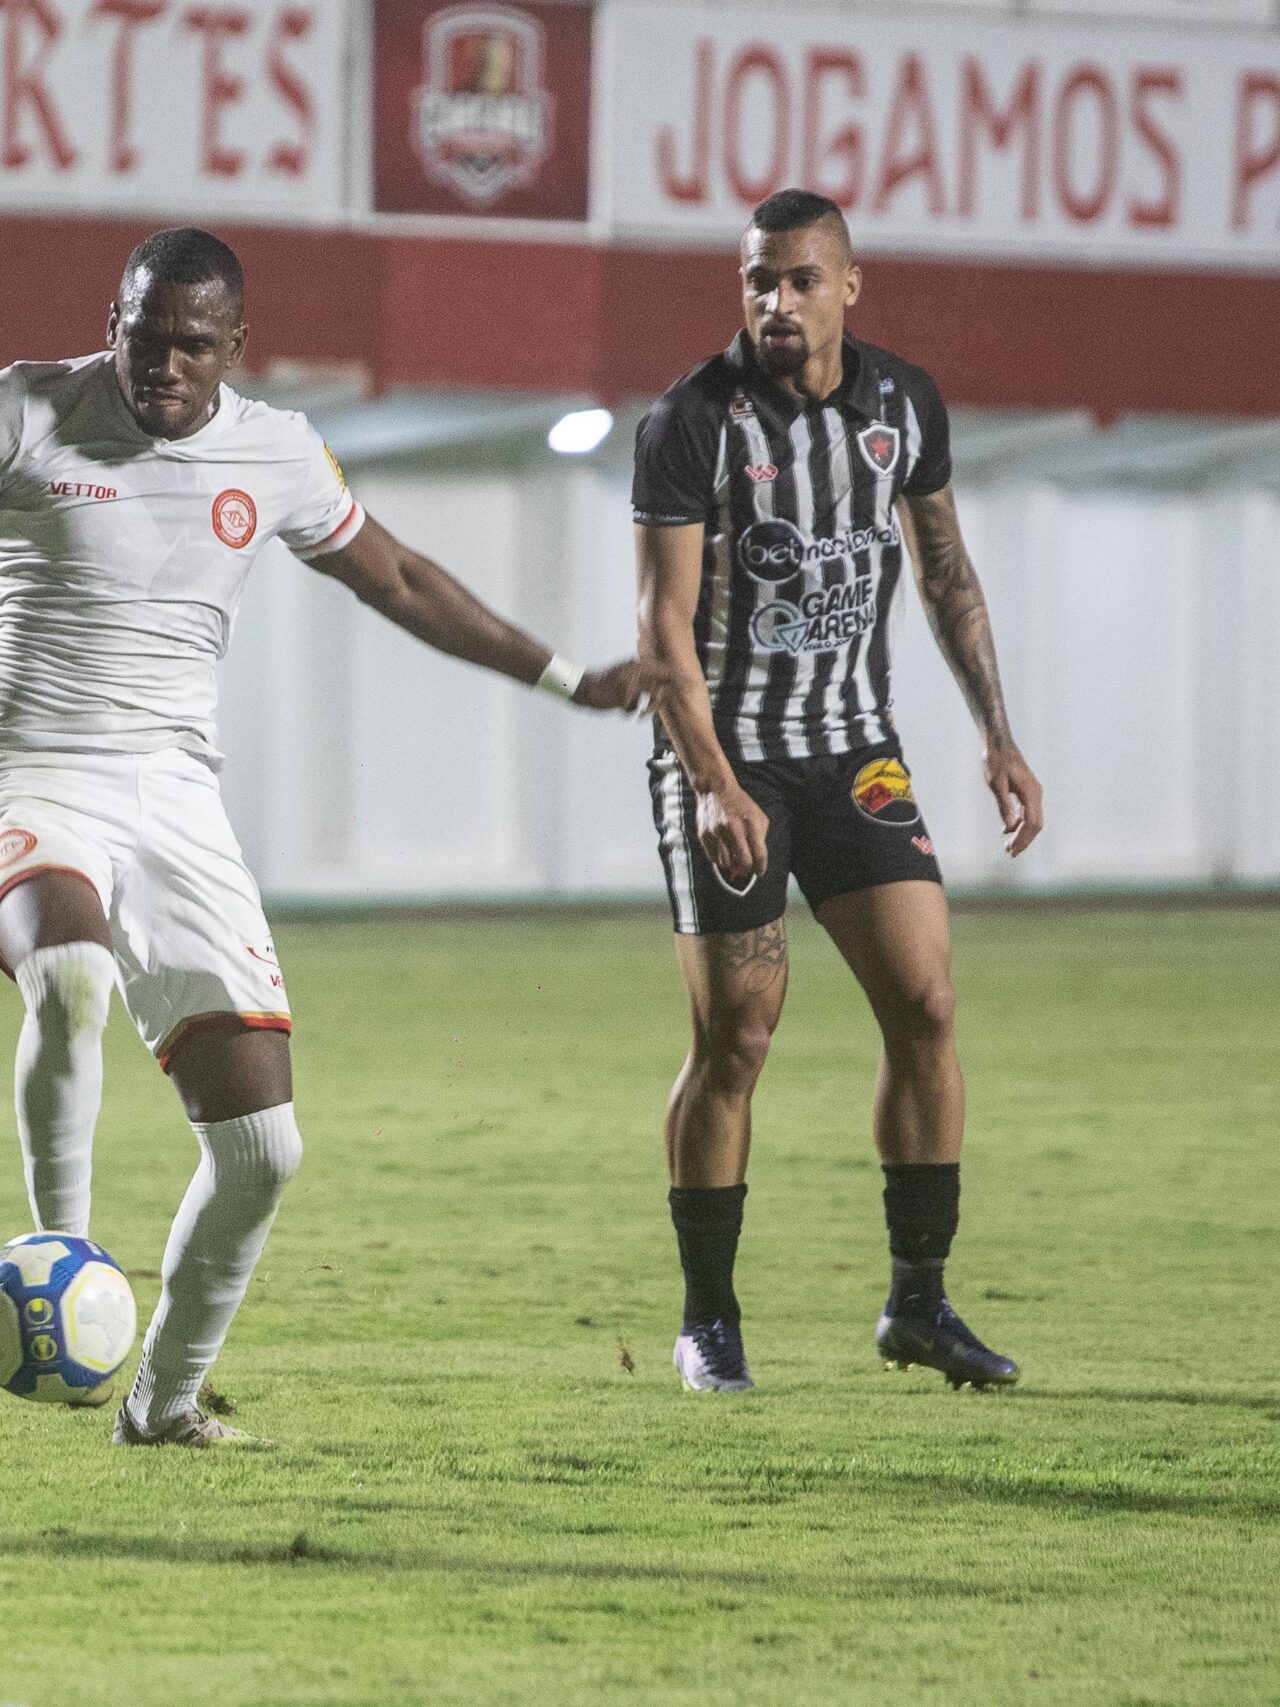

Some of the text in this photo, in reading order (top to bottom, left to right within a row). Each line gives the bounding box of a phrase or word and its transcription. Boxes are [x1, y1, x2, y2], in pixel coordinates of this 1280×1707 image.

[656, 36, 1184, 230] JOGAMOS
[50, 481, 118, 500] VETTOR
[802, 578, 873, 619] GAME
